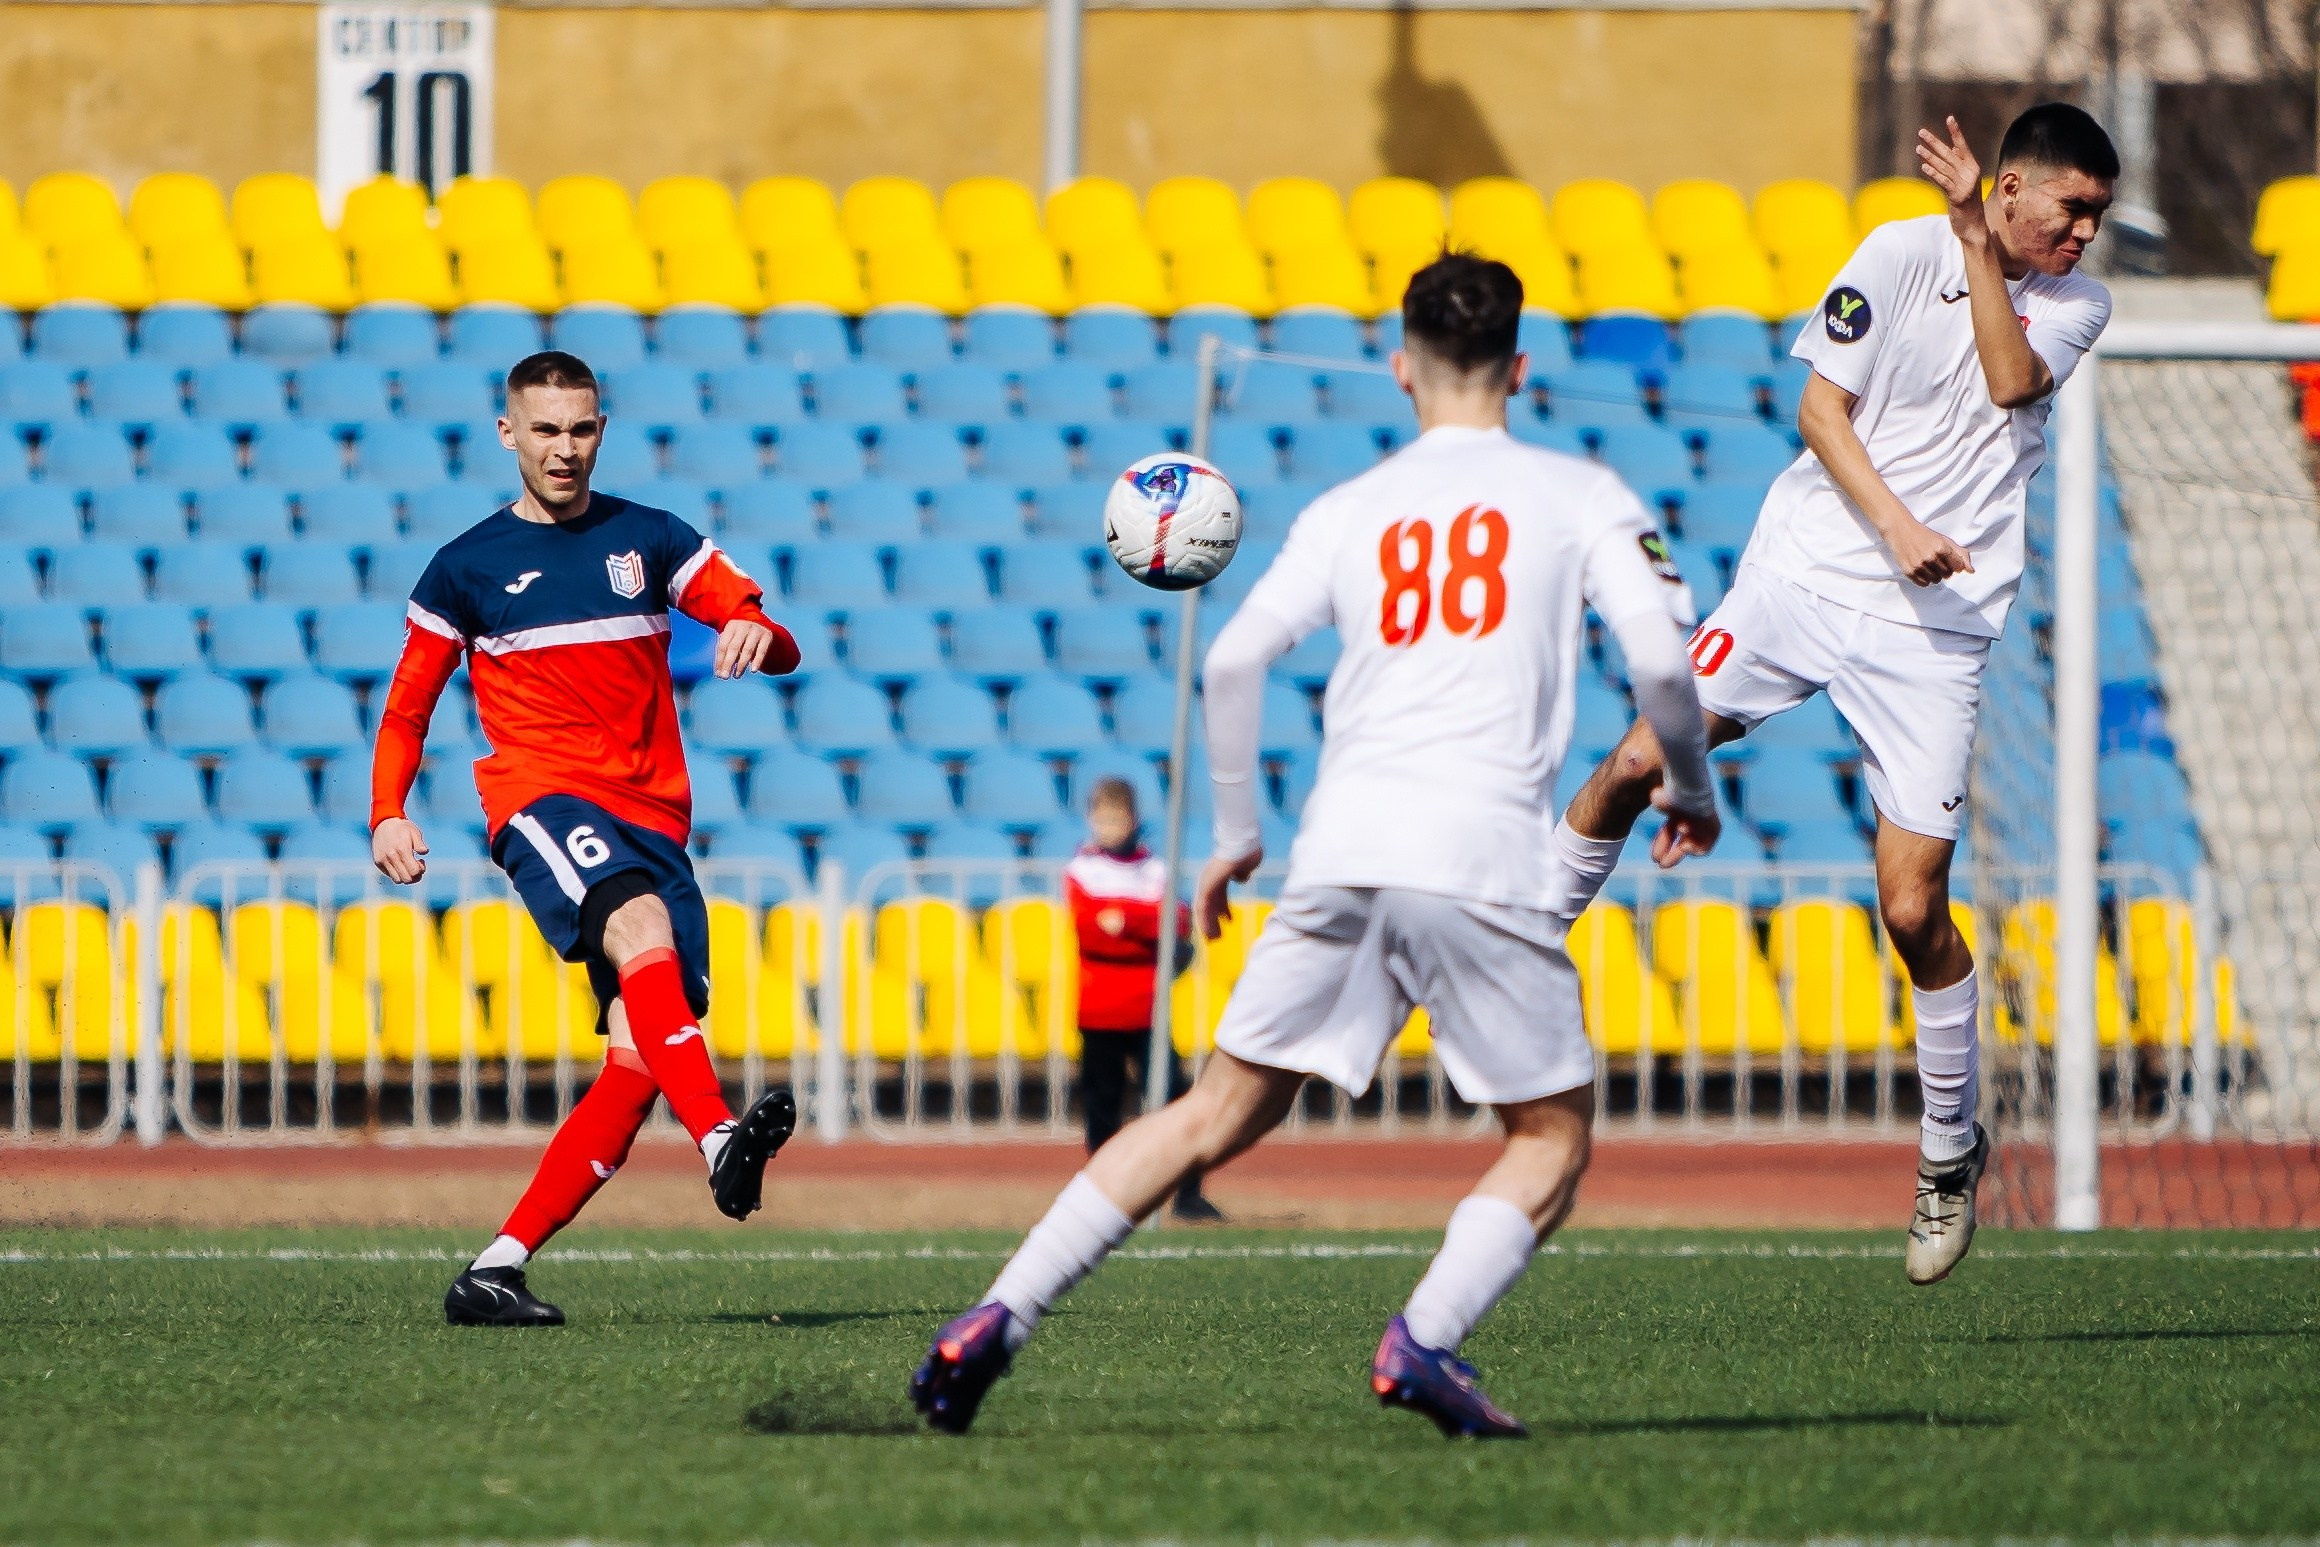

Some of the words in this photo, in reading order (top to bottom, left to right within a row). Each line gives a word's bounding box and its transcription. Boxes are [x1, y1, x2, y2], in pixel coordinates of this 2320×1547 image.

[360, 71, 470, 204] 10
[1379, 502, 1509, 647] 88
[566, 825, 611, 869] 6
